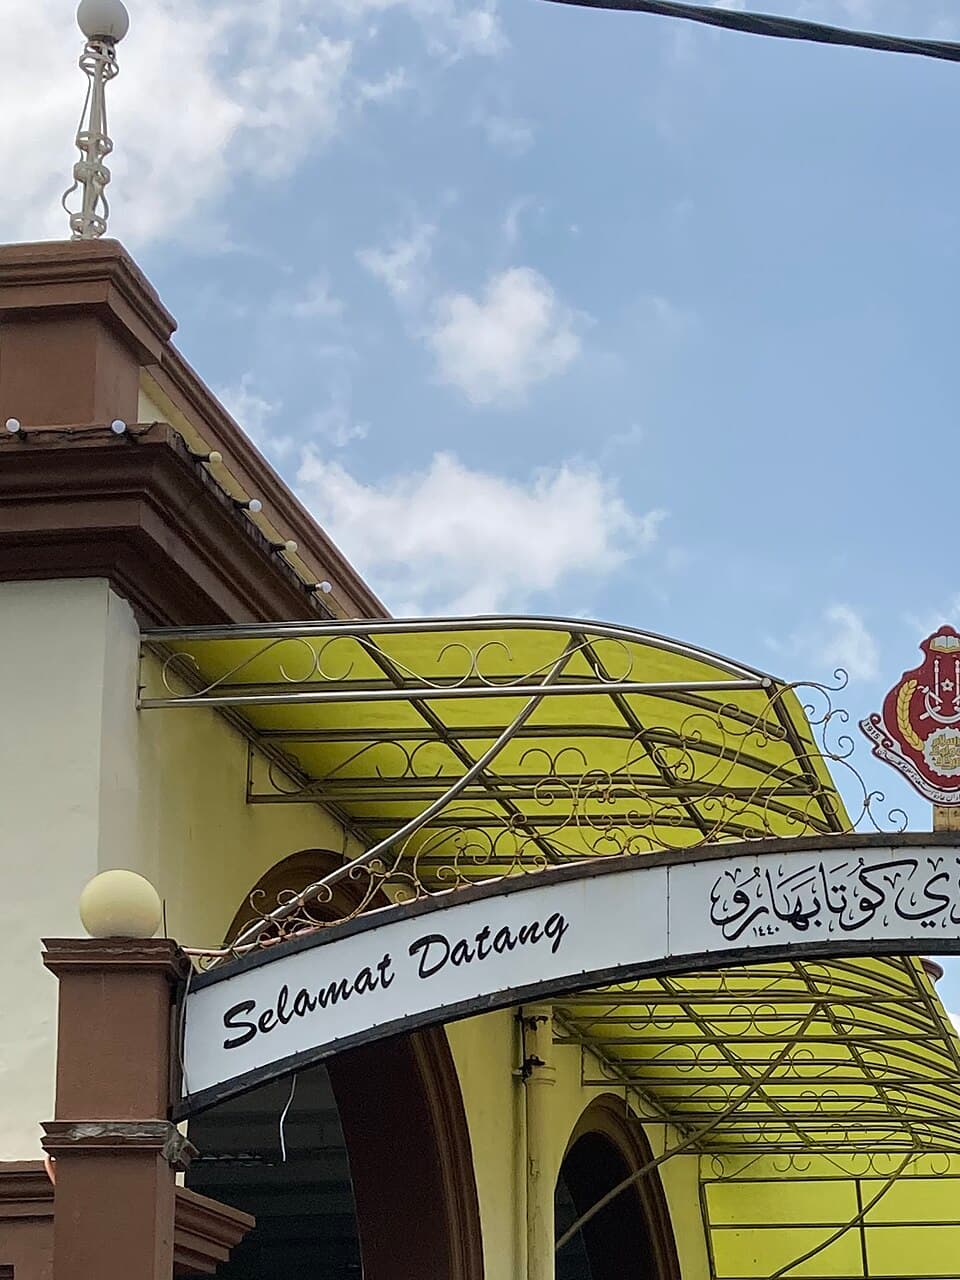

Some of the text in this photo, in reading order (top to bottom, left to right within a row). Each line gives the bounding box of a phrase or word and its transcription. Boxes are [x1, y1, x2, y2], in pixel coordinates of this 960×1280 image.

[863, 722, 881, 740] 1915
[222, 912, 569, 1050] Selamat Datang
